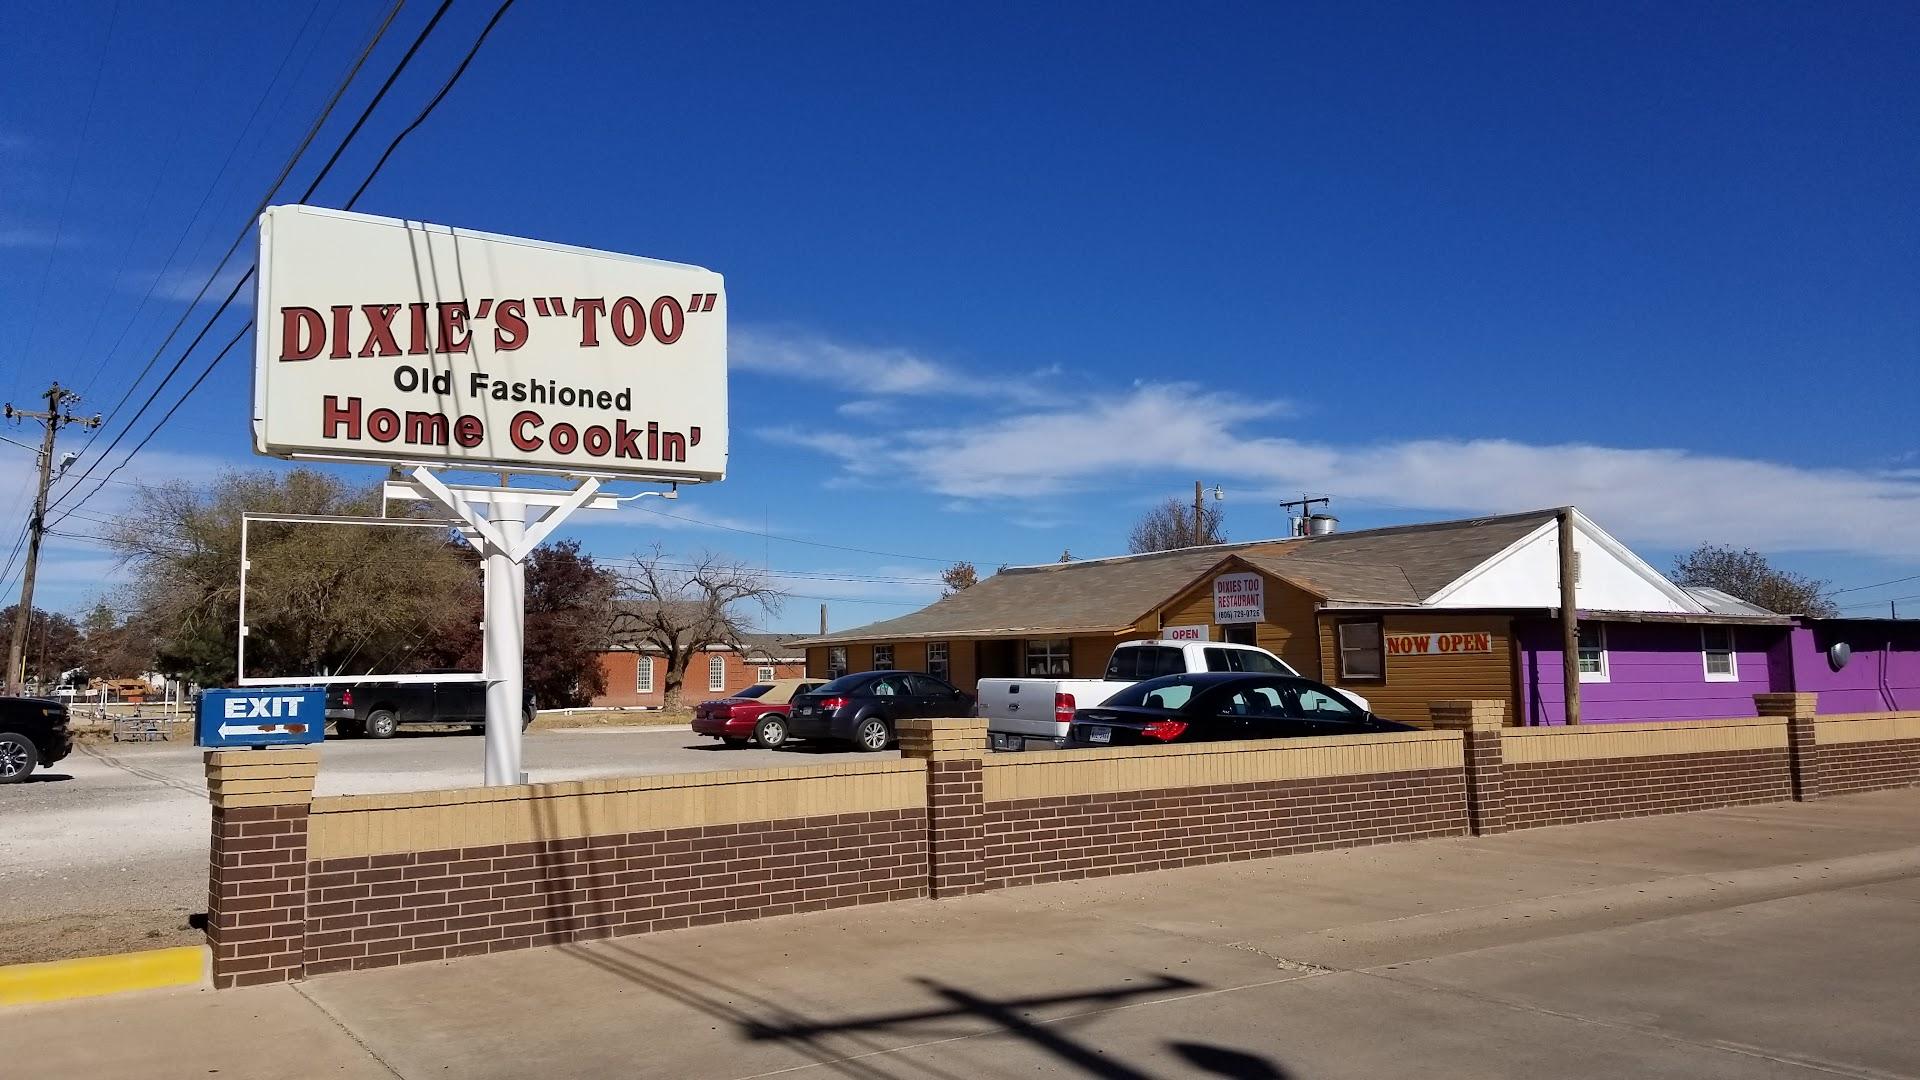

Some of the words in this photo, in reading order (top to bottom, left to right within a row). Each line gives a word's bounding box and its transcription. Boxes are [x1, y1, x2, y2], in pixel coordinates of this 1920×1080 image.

[279, 298, 529, 362] DIXIE'S
[394, 365, 451, 395] Old
[470, 372, 631, 412] Fashioned
[323, 395, 484, 448] Home
[509, 411, 701, 463] Cookin'
[1217, 579, 1242, 593] DIXIES
[1244, 579, 1259, 592] TOO
[1218, 594, 1260, 608] RESTAURANT
[1172, 629, 1199, 640] OPEN
[1387, 636, 1431, 654] NOW
[1437, 633, 1489, 652] OPEN
[224, 696, 305, 719] EXIT
